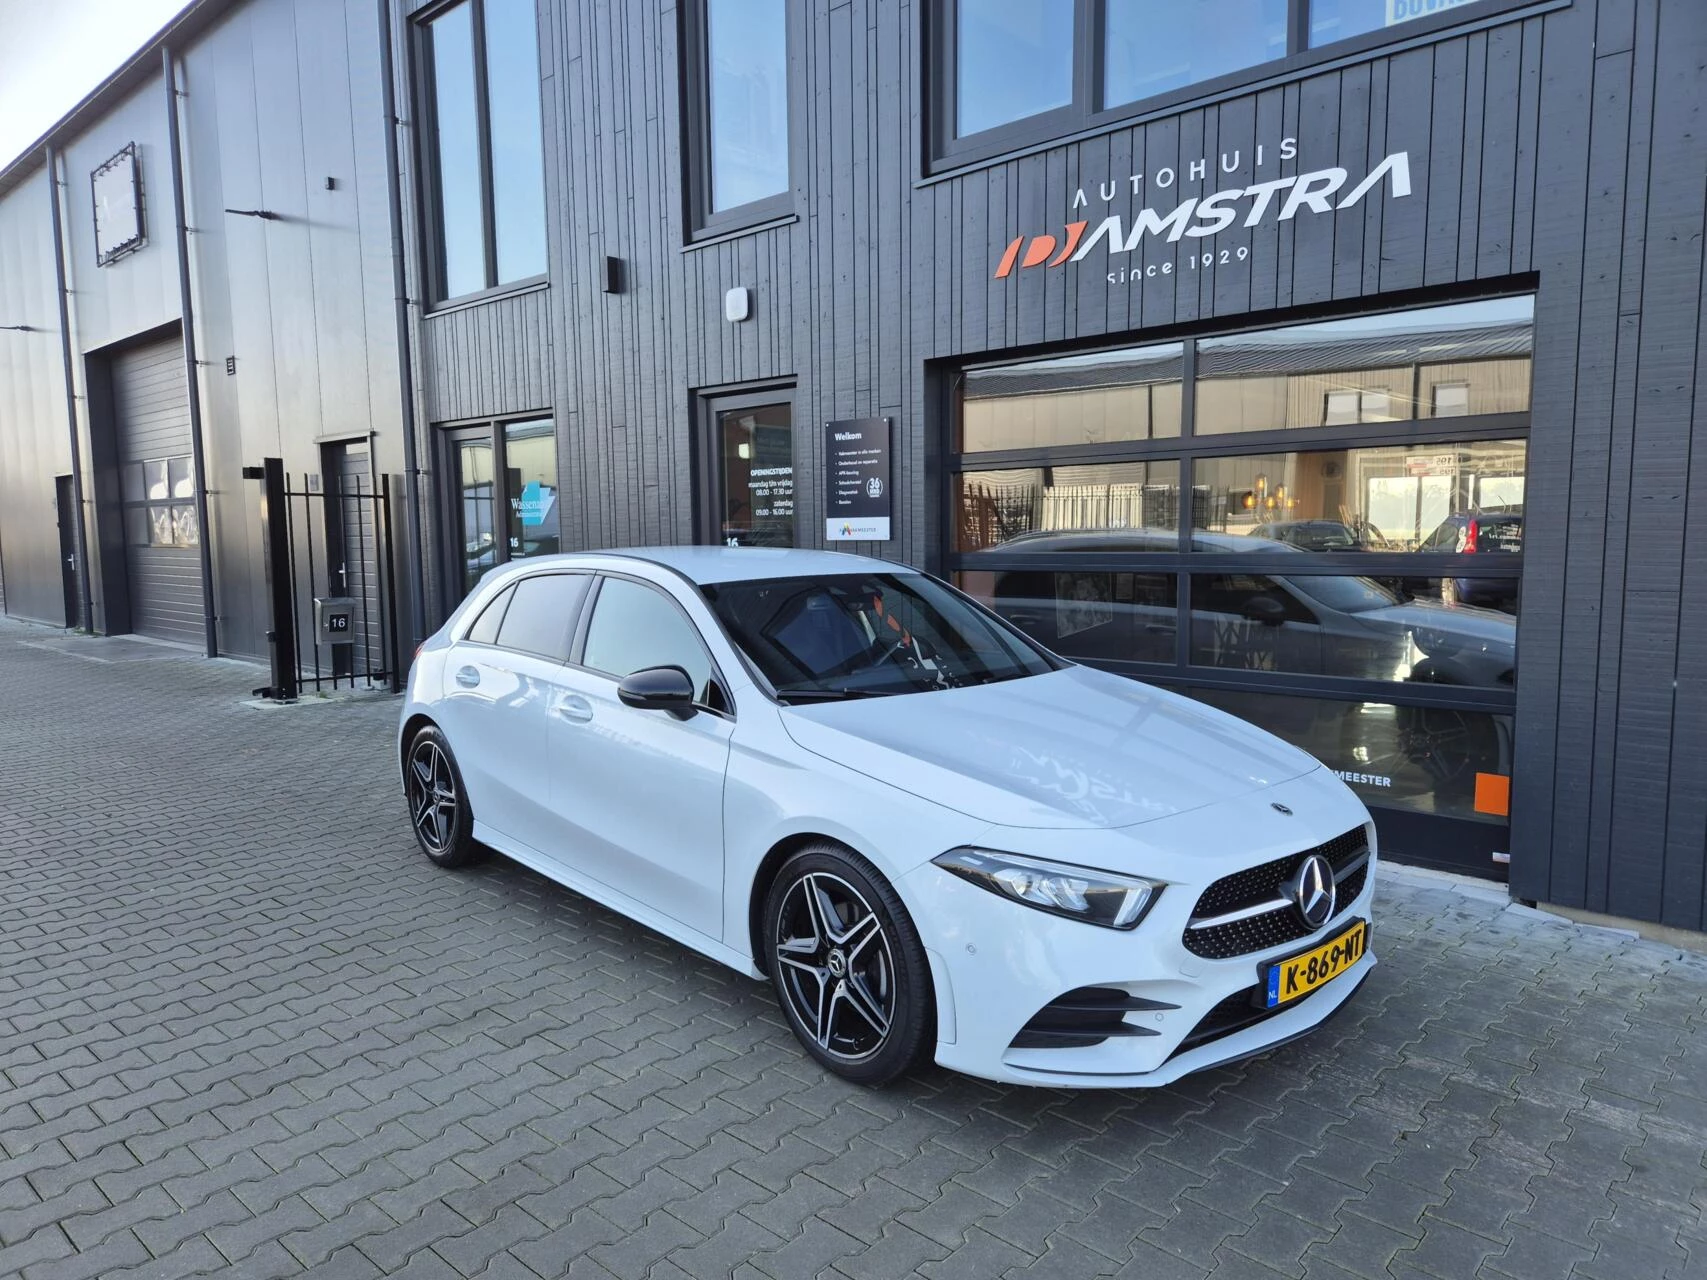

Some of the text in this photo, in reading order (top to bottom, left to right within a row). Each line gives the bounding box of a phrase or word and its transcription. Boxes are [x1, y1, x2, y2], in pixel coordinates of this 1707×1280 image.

[1073, 138, 1297, 208] AUTOHUIS
[1107, 246, 1248, 284] since 1929
[834, 432, 862, 441] Welkom
[750, 467, 792, 476] OPENINGSTIJDEN
[869, 477, 880, 489] 36
[510, 537, 519, 548] 16
[726, 537, 739, 547] 16
[332, 618, 346, 628] 16
[1333, 769, 1391, 788] MEESTER
[1286, 928, 1362, 995] K-869-NT
[1268, 990, 1277, 1000] NL
